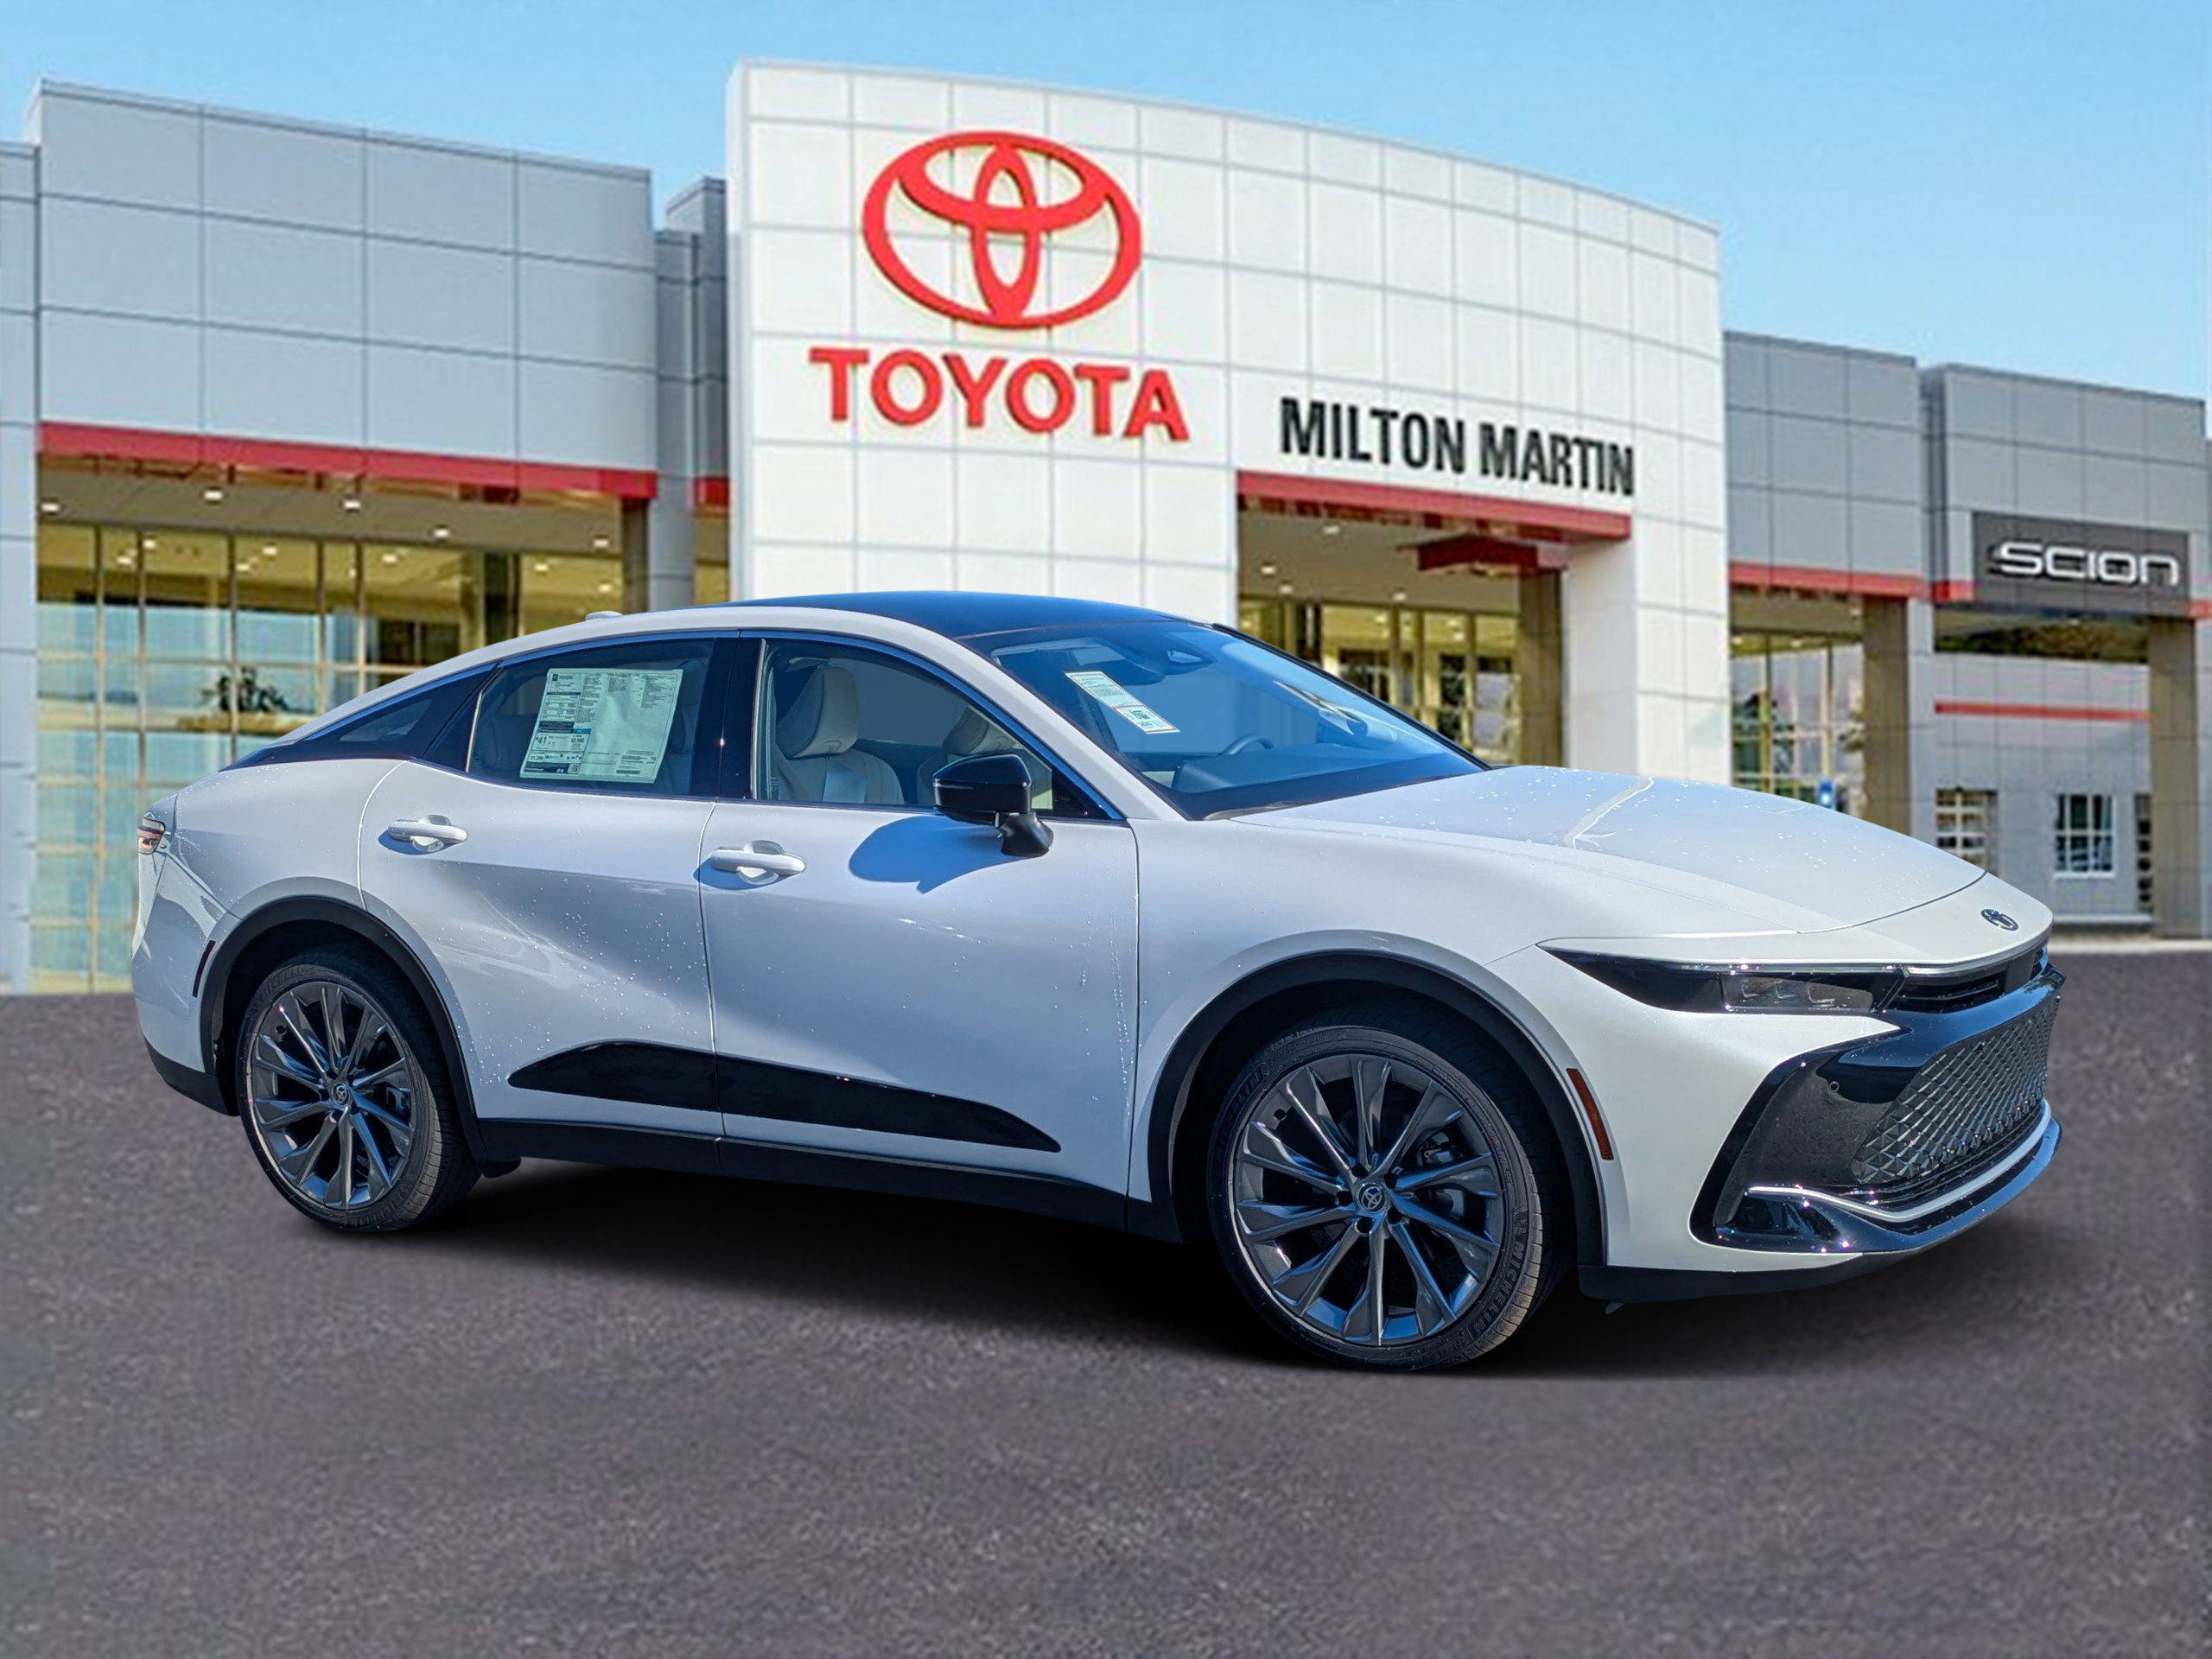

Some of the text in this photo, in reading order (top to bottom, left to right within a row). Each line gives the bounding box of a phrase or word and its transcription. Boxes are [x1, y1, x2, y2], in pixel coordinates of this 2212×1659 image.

[809, 347, 1190, 442] TOYOTA
[1281, 397, 1635, 497] MILTON MARTIN
[1472, 1240, 1526, 1337] MICHELIN
